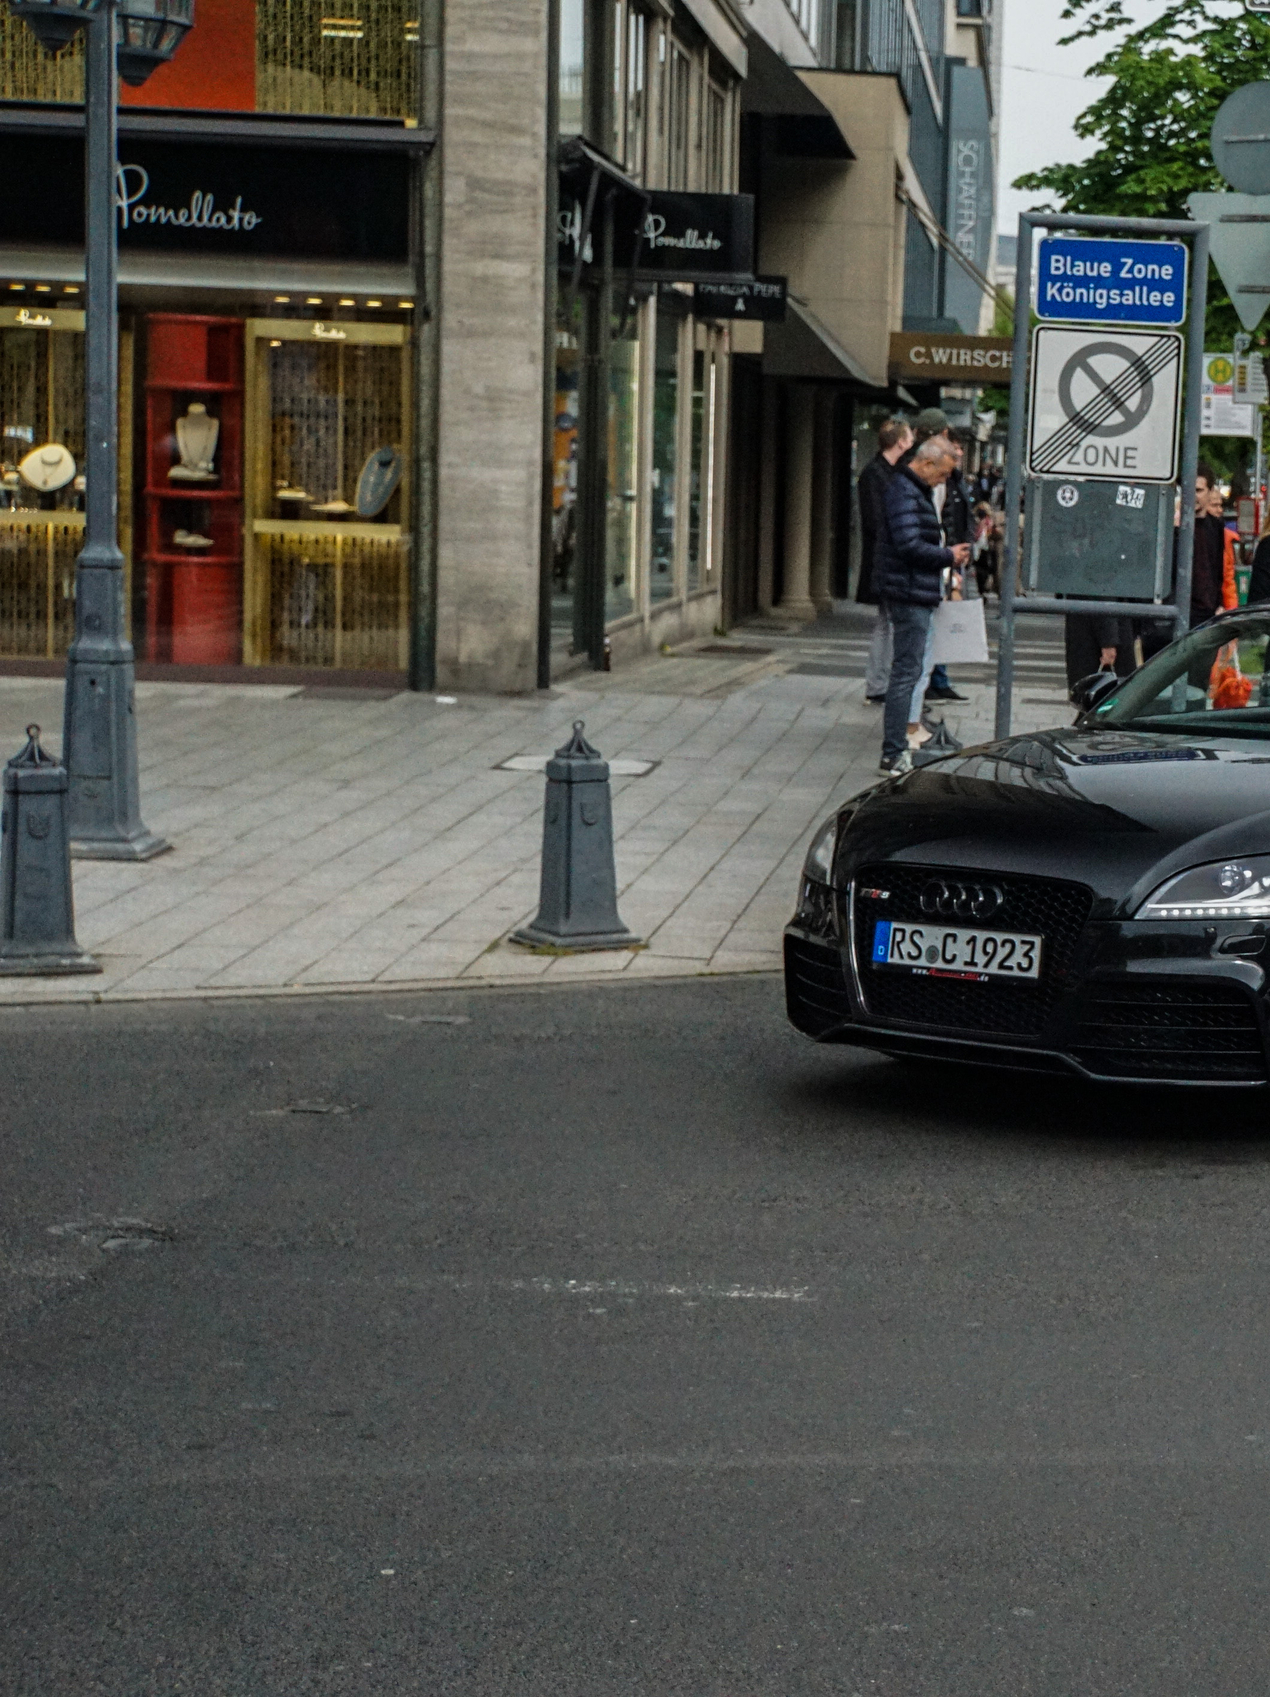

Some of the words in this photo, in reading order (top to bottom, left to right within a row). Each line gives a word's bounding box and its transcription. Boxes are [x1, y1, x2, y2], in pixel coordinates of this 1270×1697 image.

[115, 161, 262, 231] Pomellato
[642, 212, 722, 250] Pomellato
[1050, 254, 1112, 277] Blaue
[1120, 257, 1174, 280] Zone
[1046, 281, 1176, 309] Königsallee
[909, 345, 1014, 368] C.WIRSCH
[1066, 444, 1138, 469] ZONE
[889, 927, 924, 961] RS
[963, 935, 1035, 972] 1923
